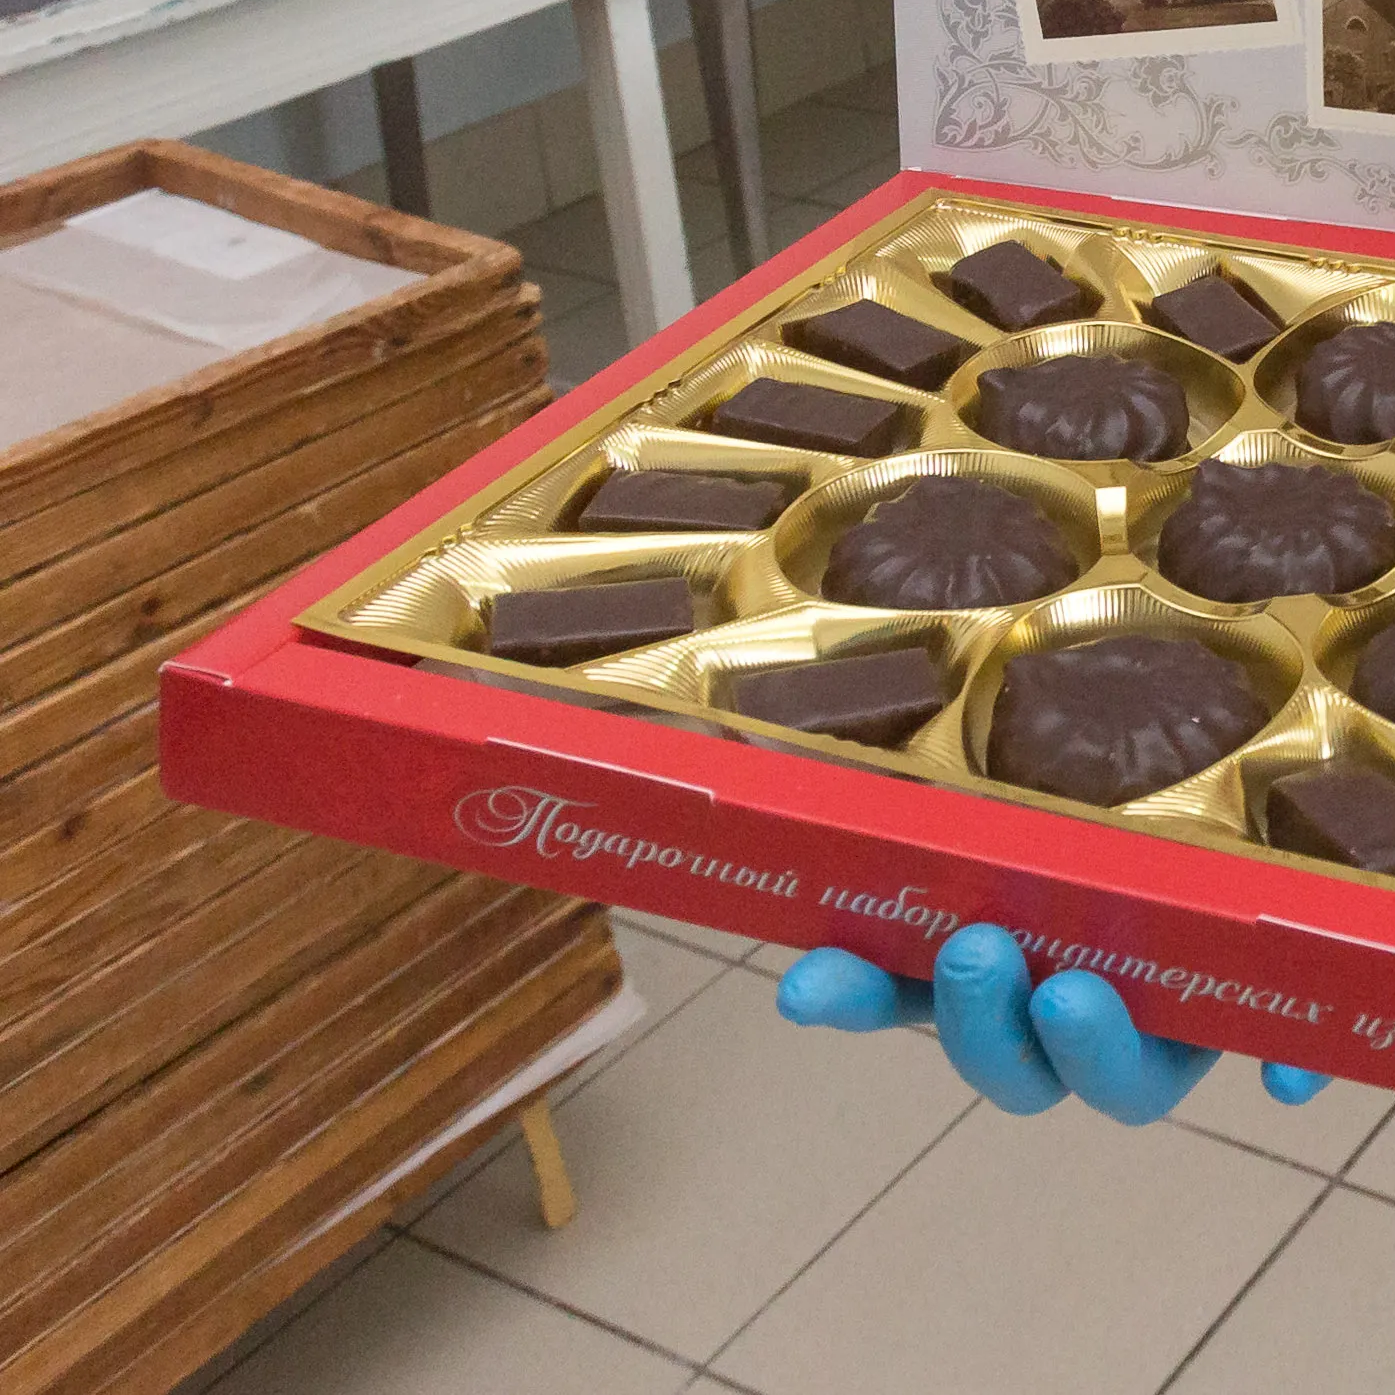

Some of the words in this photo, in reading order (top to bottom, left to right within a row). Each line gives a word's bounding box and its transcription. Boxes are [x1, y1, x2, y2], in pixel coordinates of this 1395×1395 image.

[453, 785, 800, 899] Подарочный
[818, 885, 960, 941] набор
[1003, 926, 1335, 1025] ондитерских
